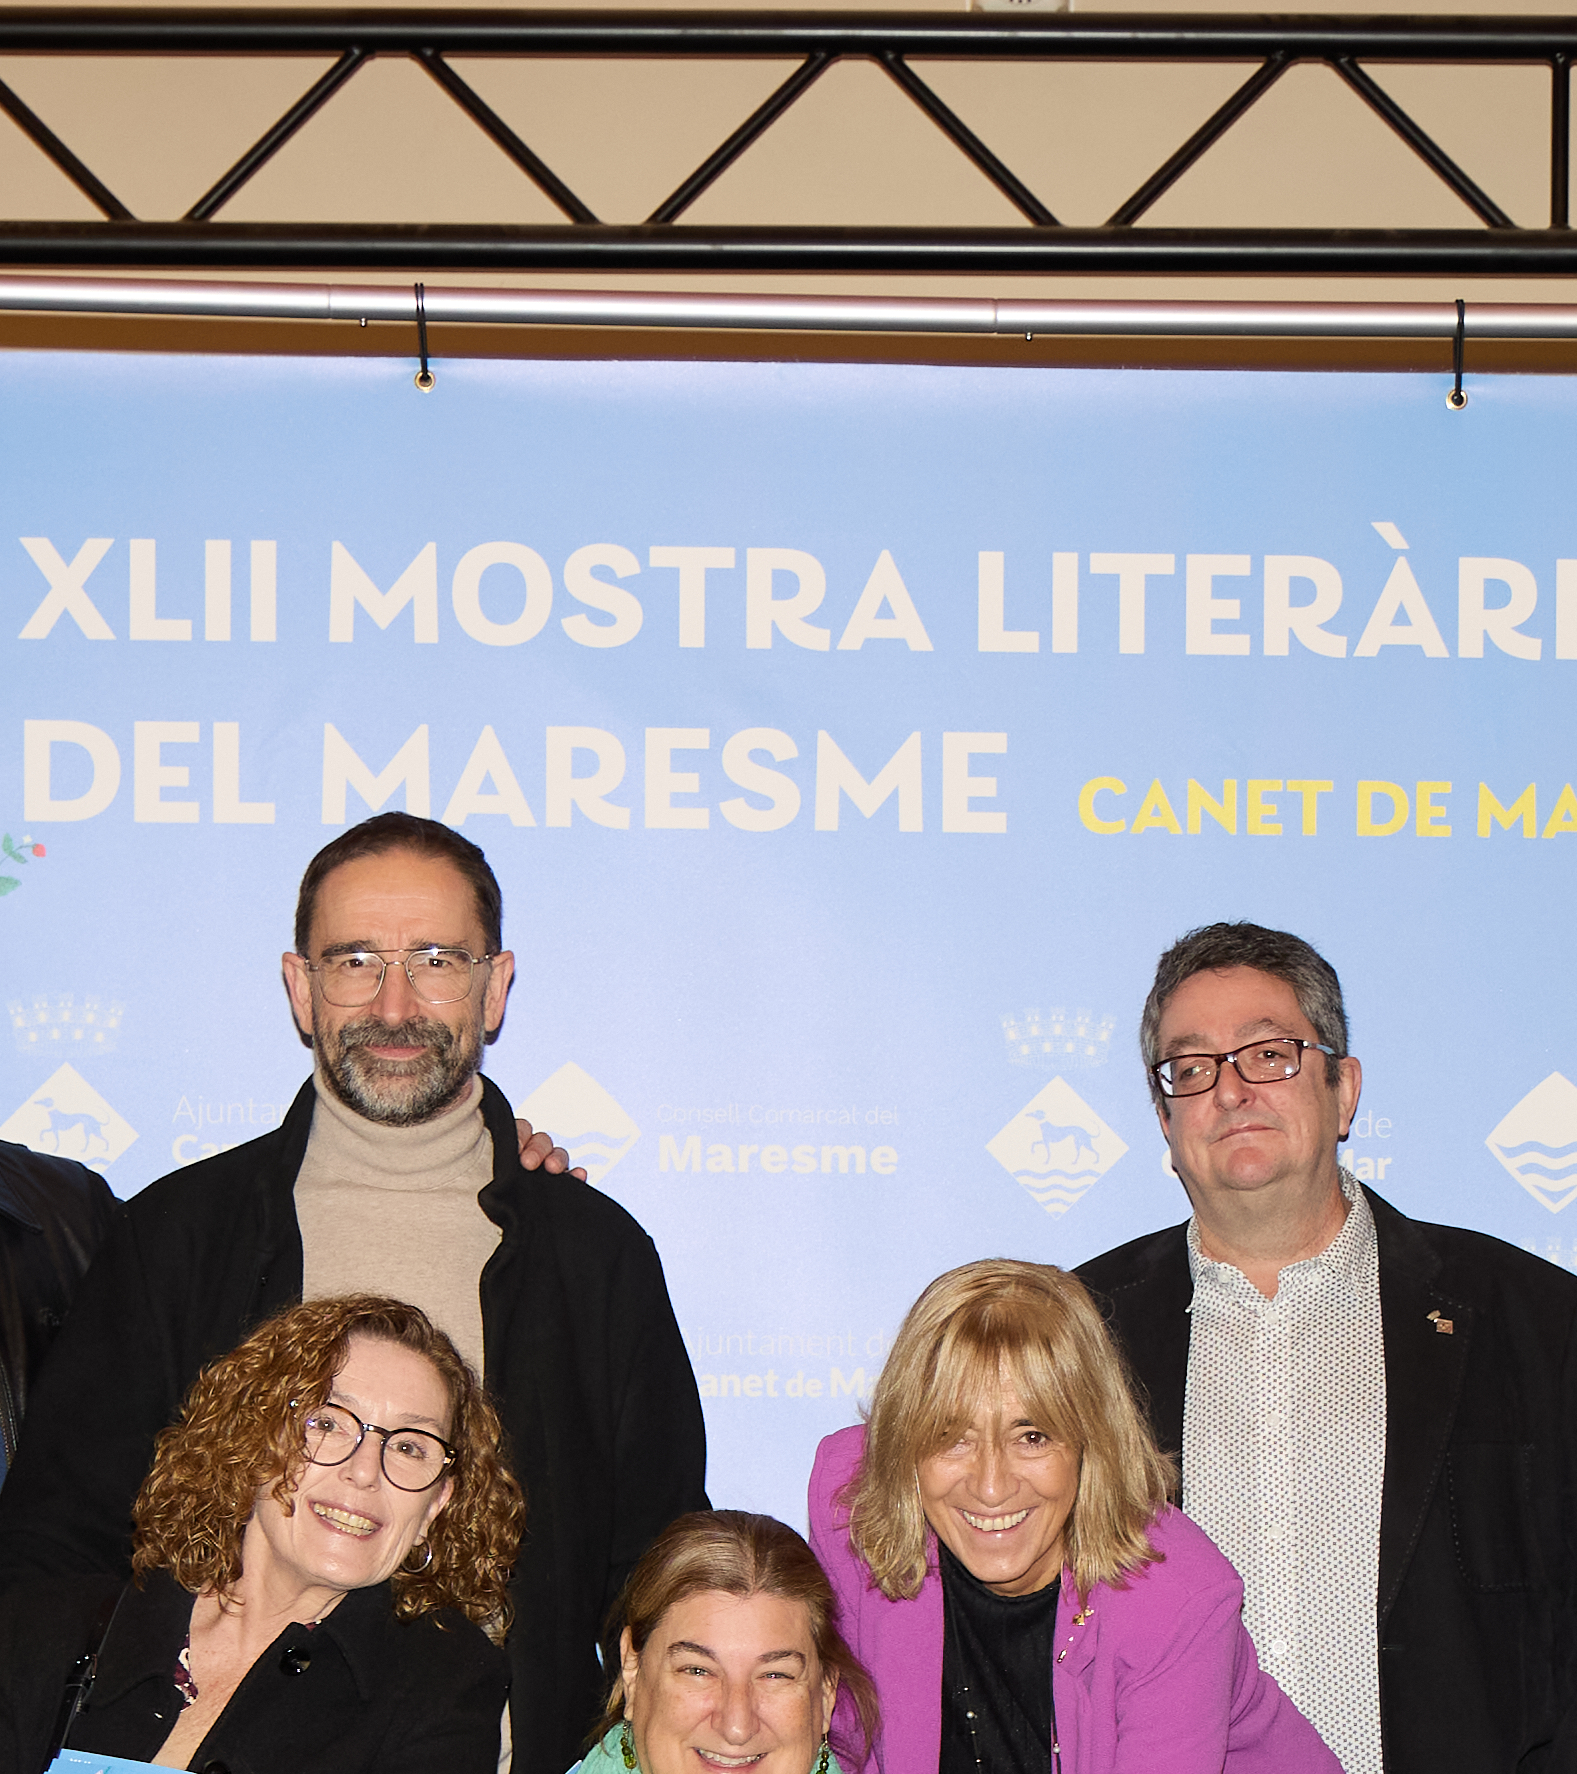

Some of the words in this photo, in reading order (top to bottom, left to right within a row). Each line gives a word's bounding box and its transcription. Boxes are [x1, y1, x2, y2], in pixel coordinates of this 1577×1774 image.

[20, 537, 277, 641] XLII
[329, 541, 934, 652] MOSTRA
[24, 719, 276, 824] DEL
[321, 722, 1008, 833] MARESME
[1078, 776, 1333, 836] CANET
[1357, 780, 1452, 837] DE
[172, 1095, 289, 1130] Ajunta
[657, 1103, 740, 1124] Consell
[748, 1104, 859, 1125] Comarcal
[864, 1104, 898, 1125] del
[1355, 1109, 1392, 1138] de
[659, 1135, 898, 1175] Maresme
[699, 1369, 779, 1398] anet
[785, 1370, 822, 1398] de
